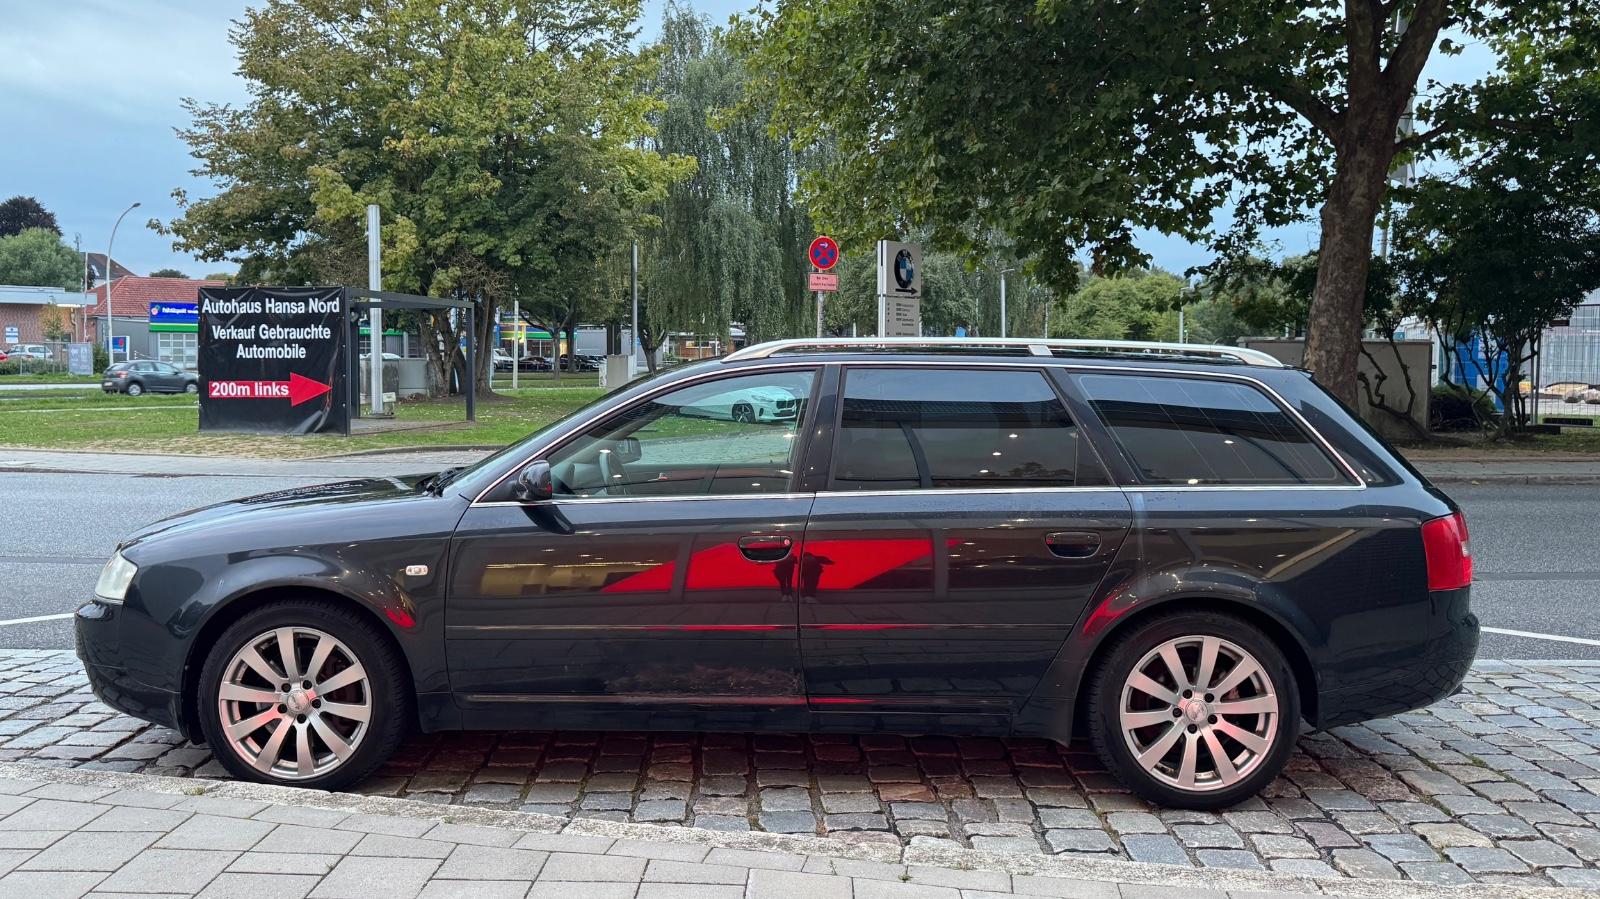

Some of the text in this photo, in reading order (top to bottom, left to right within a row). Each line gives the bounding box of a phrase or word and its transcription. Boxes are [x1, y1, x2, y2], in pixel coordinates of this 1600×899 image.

[202, 299, 261, 313] Autohaus
[265, 298, 305, 313] Hansa
[309, 297, 340, 313] Nord
[212, 324, 331, 339] Verkauf Gebrauchte
[236, 344, 306, 358] Automobile
[212, 383, 289, 396] 200m links
